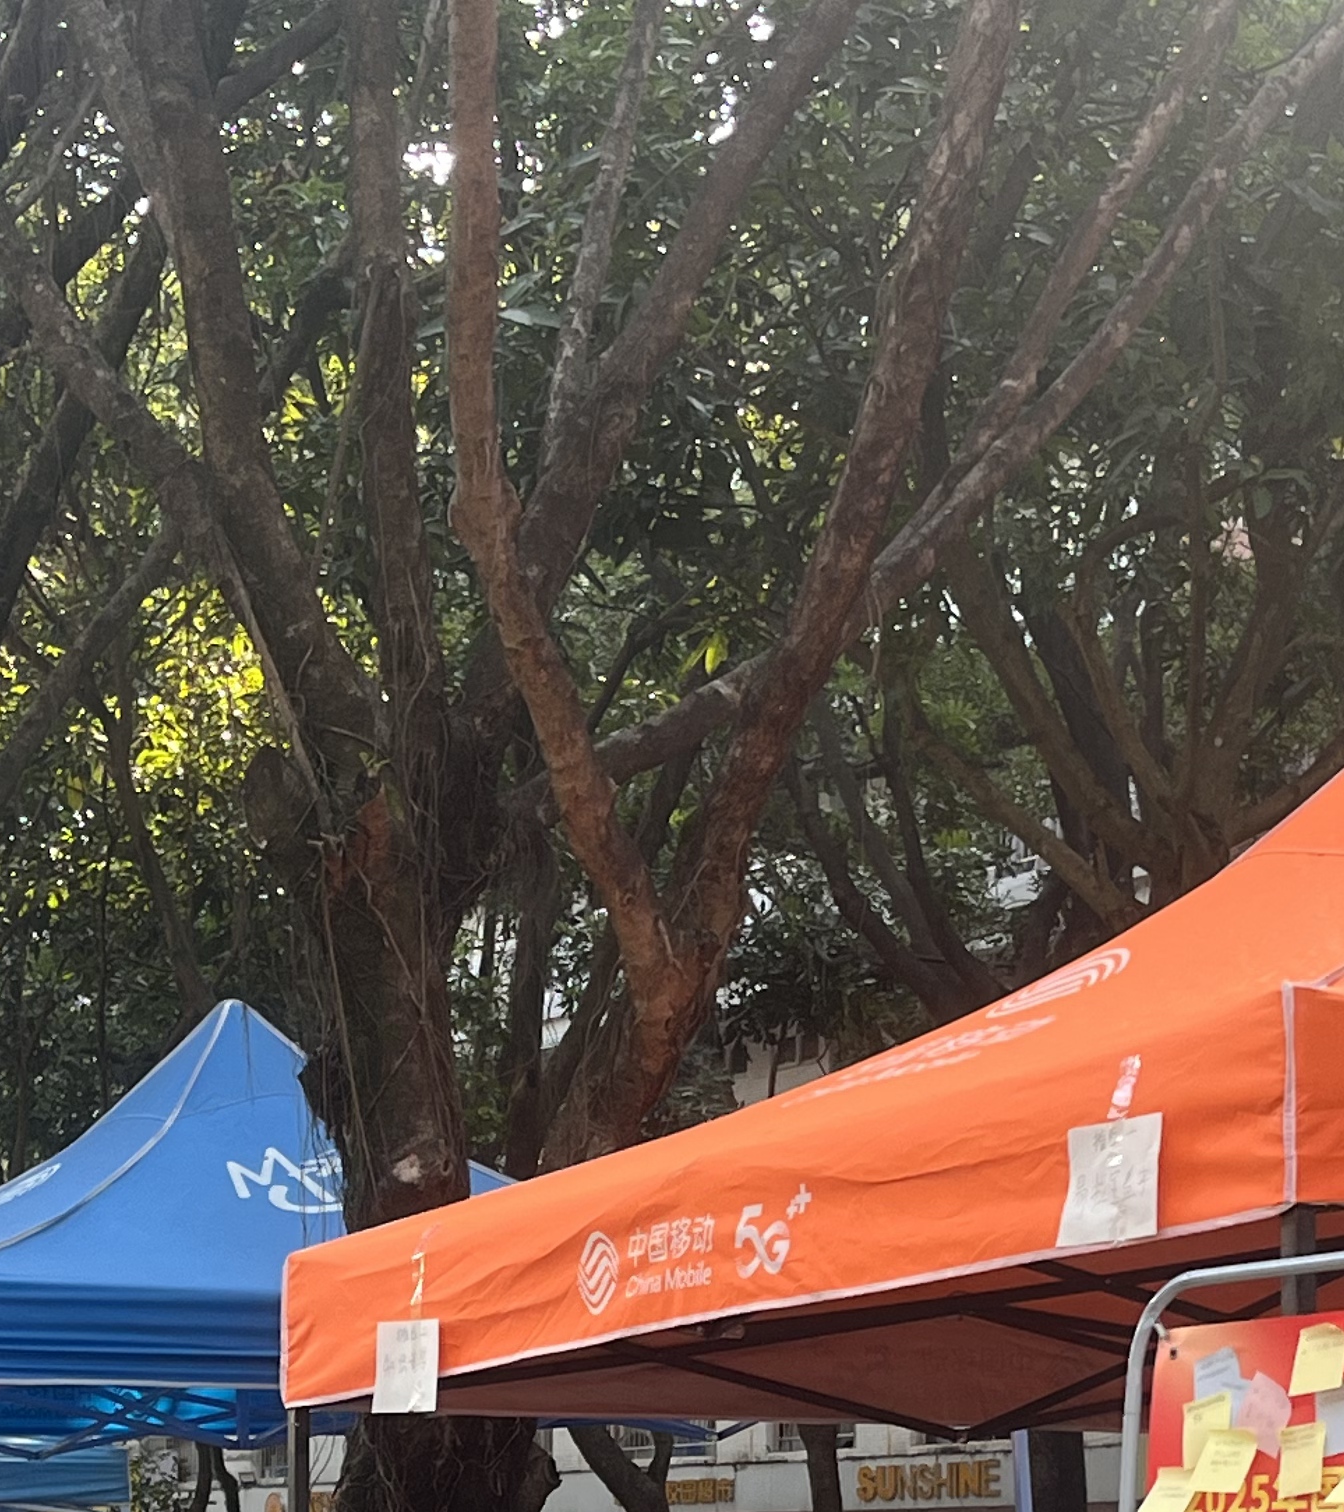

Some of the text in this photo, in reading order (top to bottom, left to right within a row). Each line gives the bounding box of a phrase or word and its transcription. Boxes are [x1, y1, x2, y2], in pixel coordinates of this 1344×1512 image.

[627, 1212, 715, 1267] 中国移动
[625, 1261, 712, 1298] China Mobile
[857, 1459, 1001, 1501] SUNSHINE
